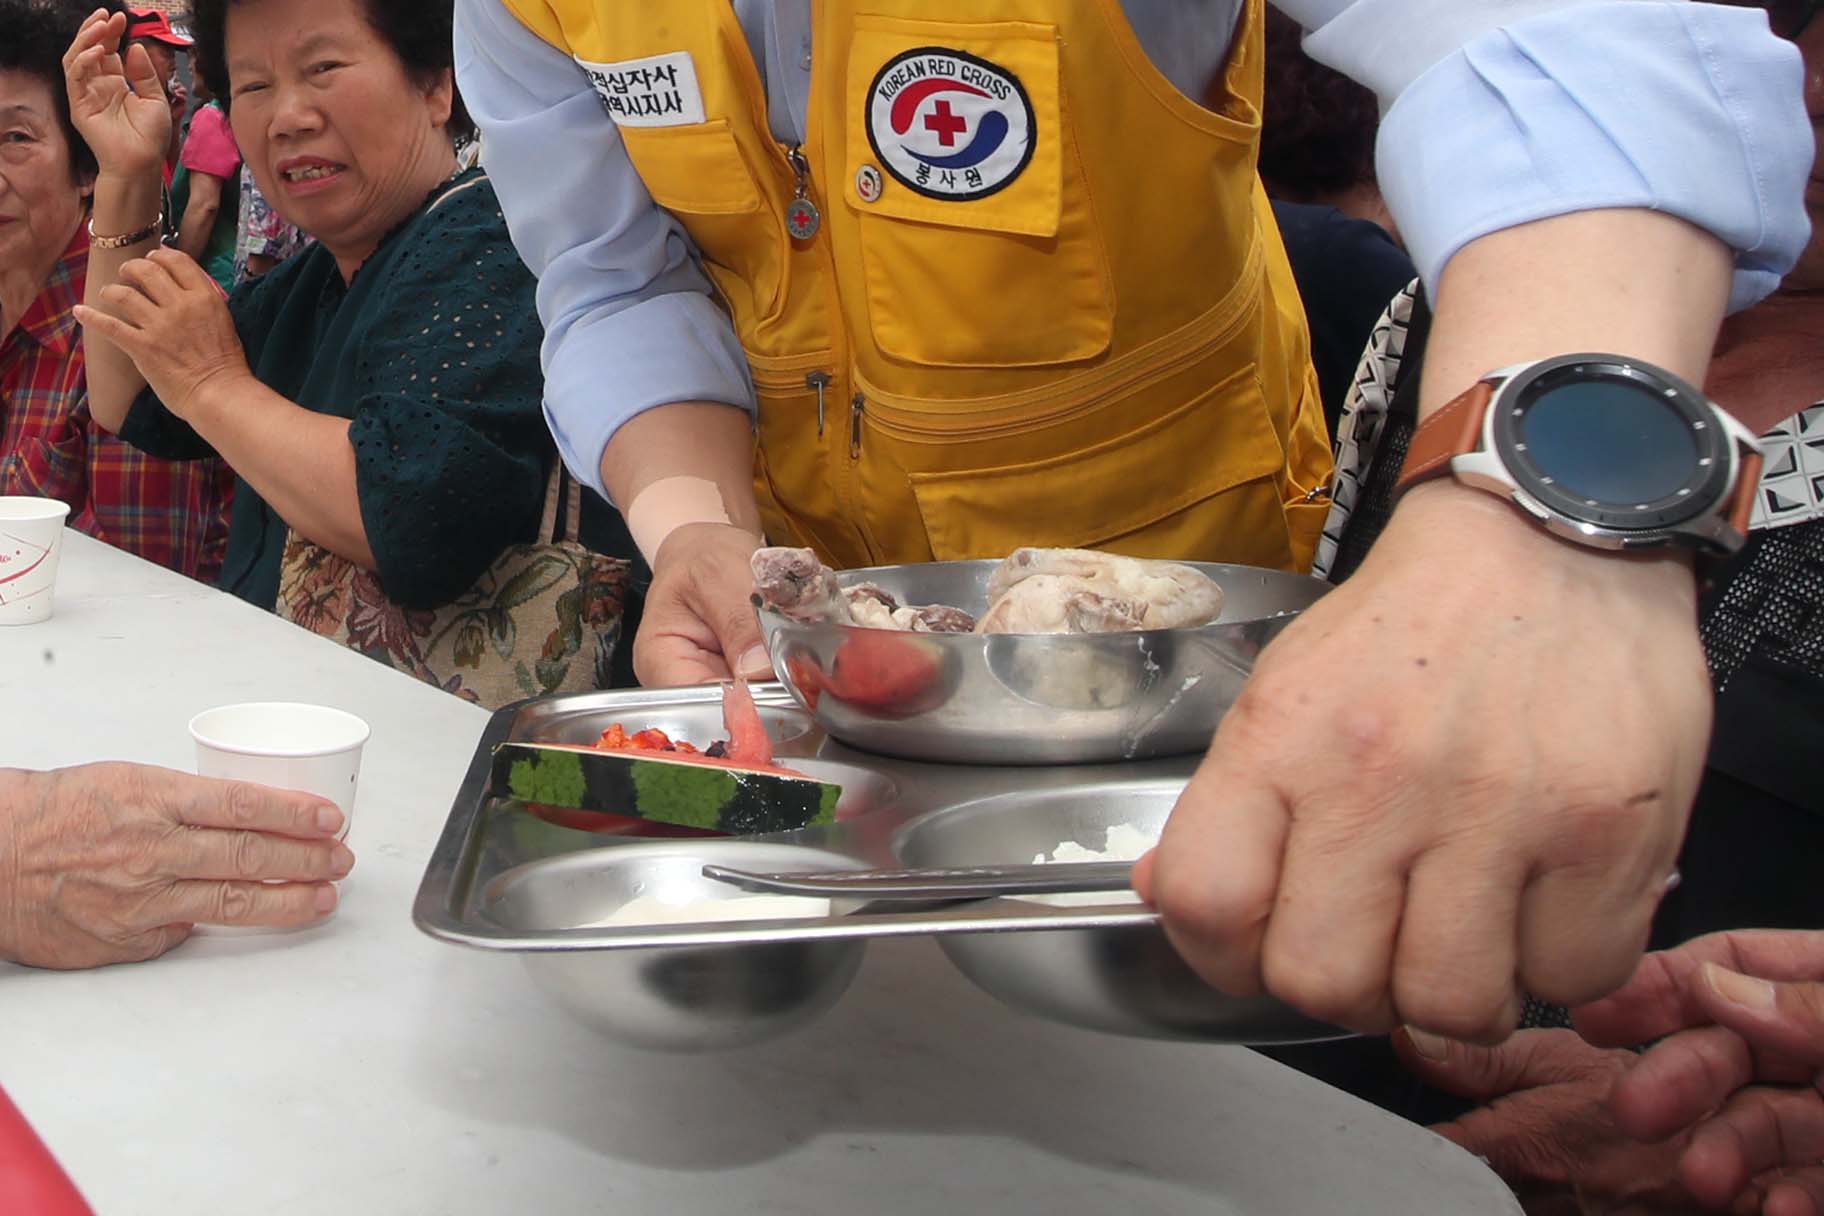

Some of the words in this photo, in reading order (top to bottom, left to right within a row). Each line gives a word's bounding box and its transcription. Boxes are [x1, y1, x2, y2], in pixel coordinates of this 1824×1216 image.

[879, 58, 926, 102] KOREAN
[928, 58, 956, 76] RED
[961, 65, 1011, 100] CROSS
[916, 162, 983, 189] 봉사원
